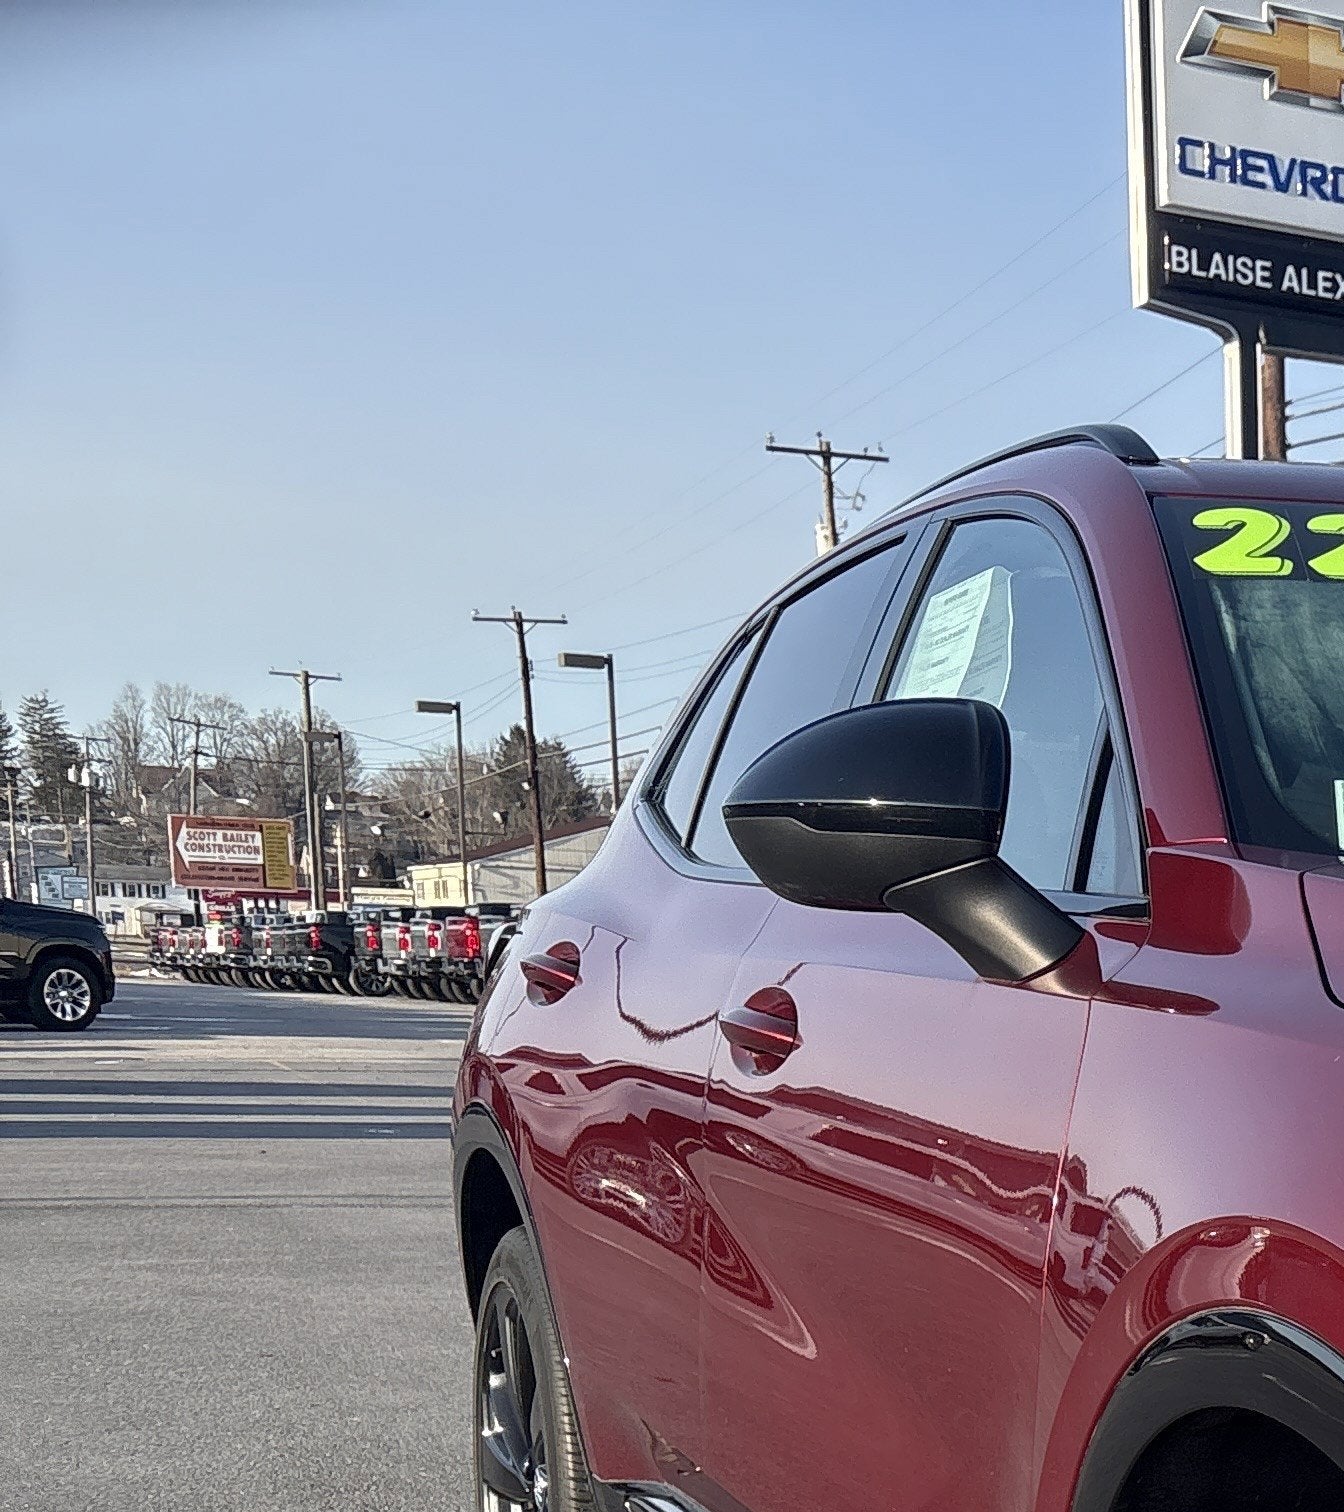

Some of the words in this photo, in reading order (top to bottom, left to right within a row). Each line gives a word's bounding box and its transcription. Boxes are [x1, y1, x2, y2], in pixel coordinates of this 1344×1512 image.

[1171, 245, 1273, 288] BLAISE
[186, 831, 218, 841] SCOTT
[222, 832, 256, 844] BAILEY
[184, 842, 260, 855] CONSTRUCTION
